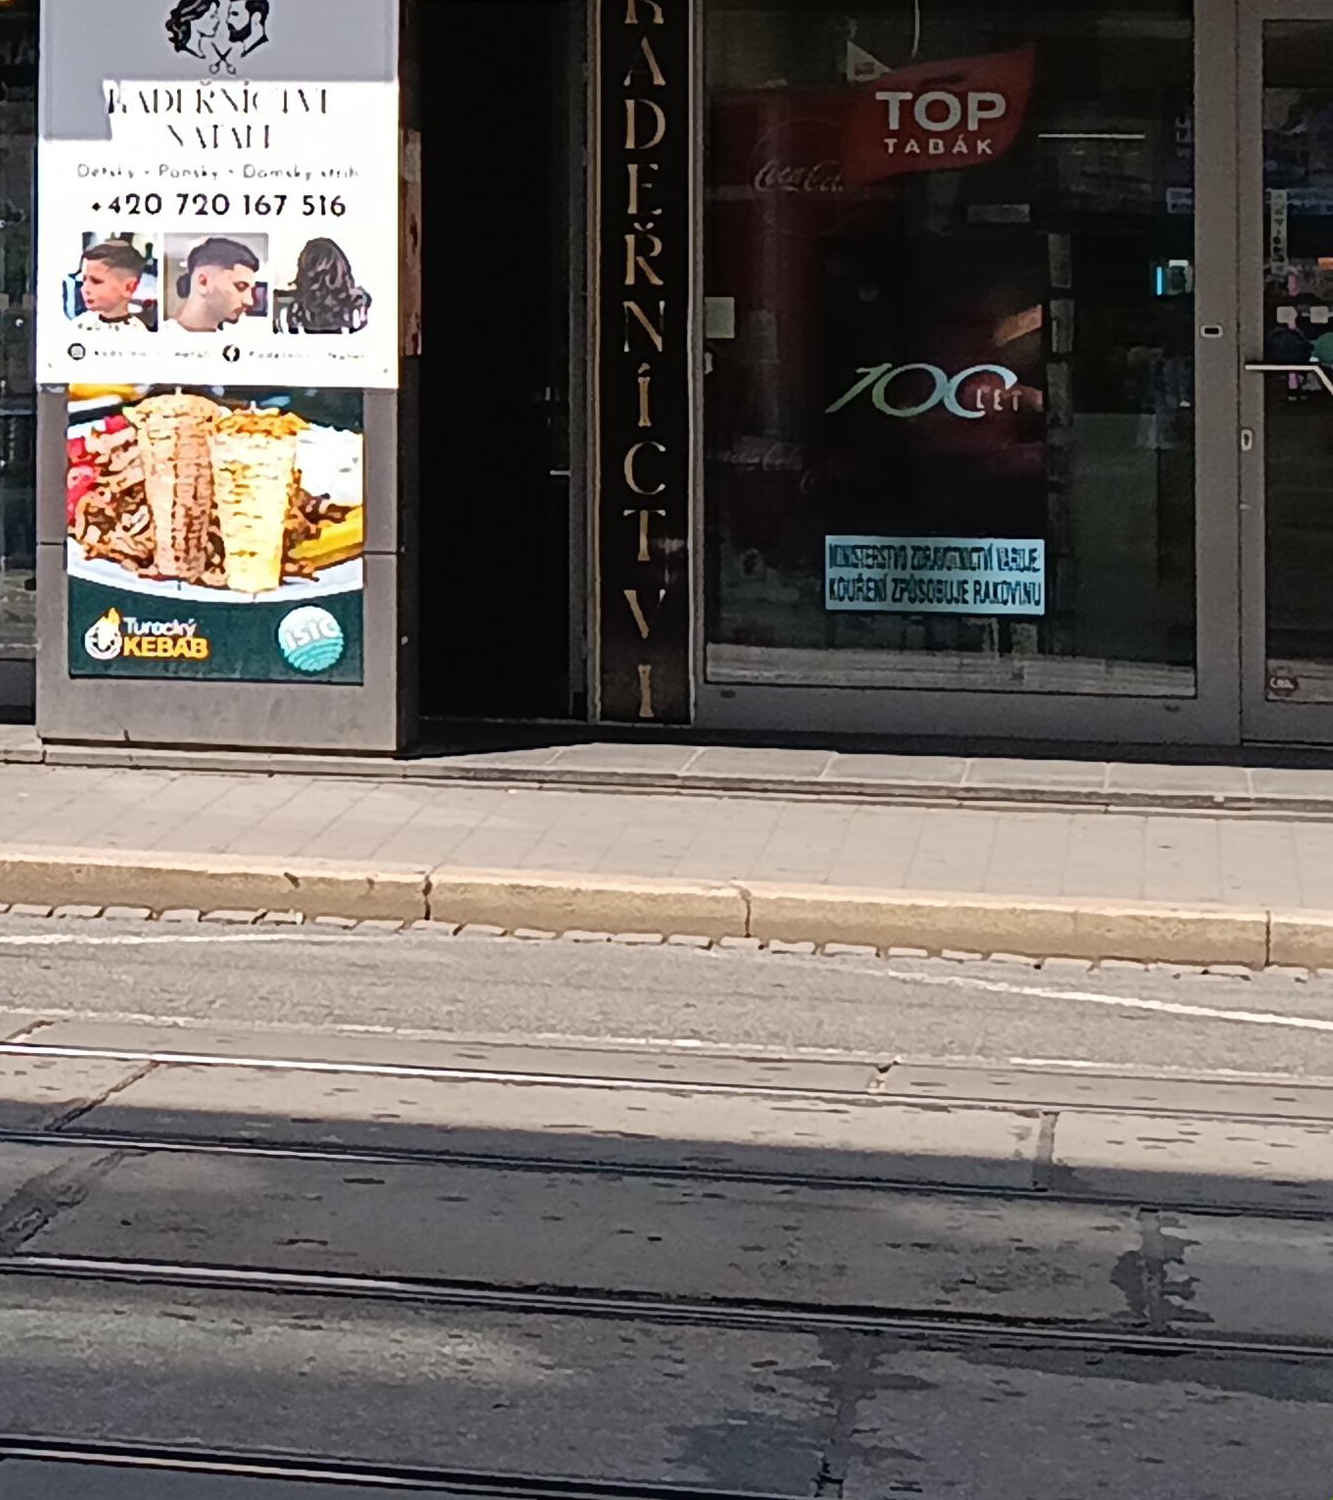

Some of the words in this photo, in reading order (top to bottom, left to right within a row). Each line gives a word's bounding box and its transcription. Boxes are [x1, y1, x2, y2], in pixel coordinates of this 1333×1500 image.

[875, 91, 1006, 132] TOP
[884, 134, 993, 155] TABÁK
[92, 193, 162, 215] +420
[176, 193, 230, 215] 720
[243, 194, 287, 215] 167
[302, 194, 346, 217] 516
[123, 636, 209, 659] KEBAB
